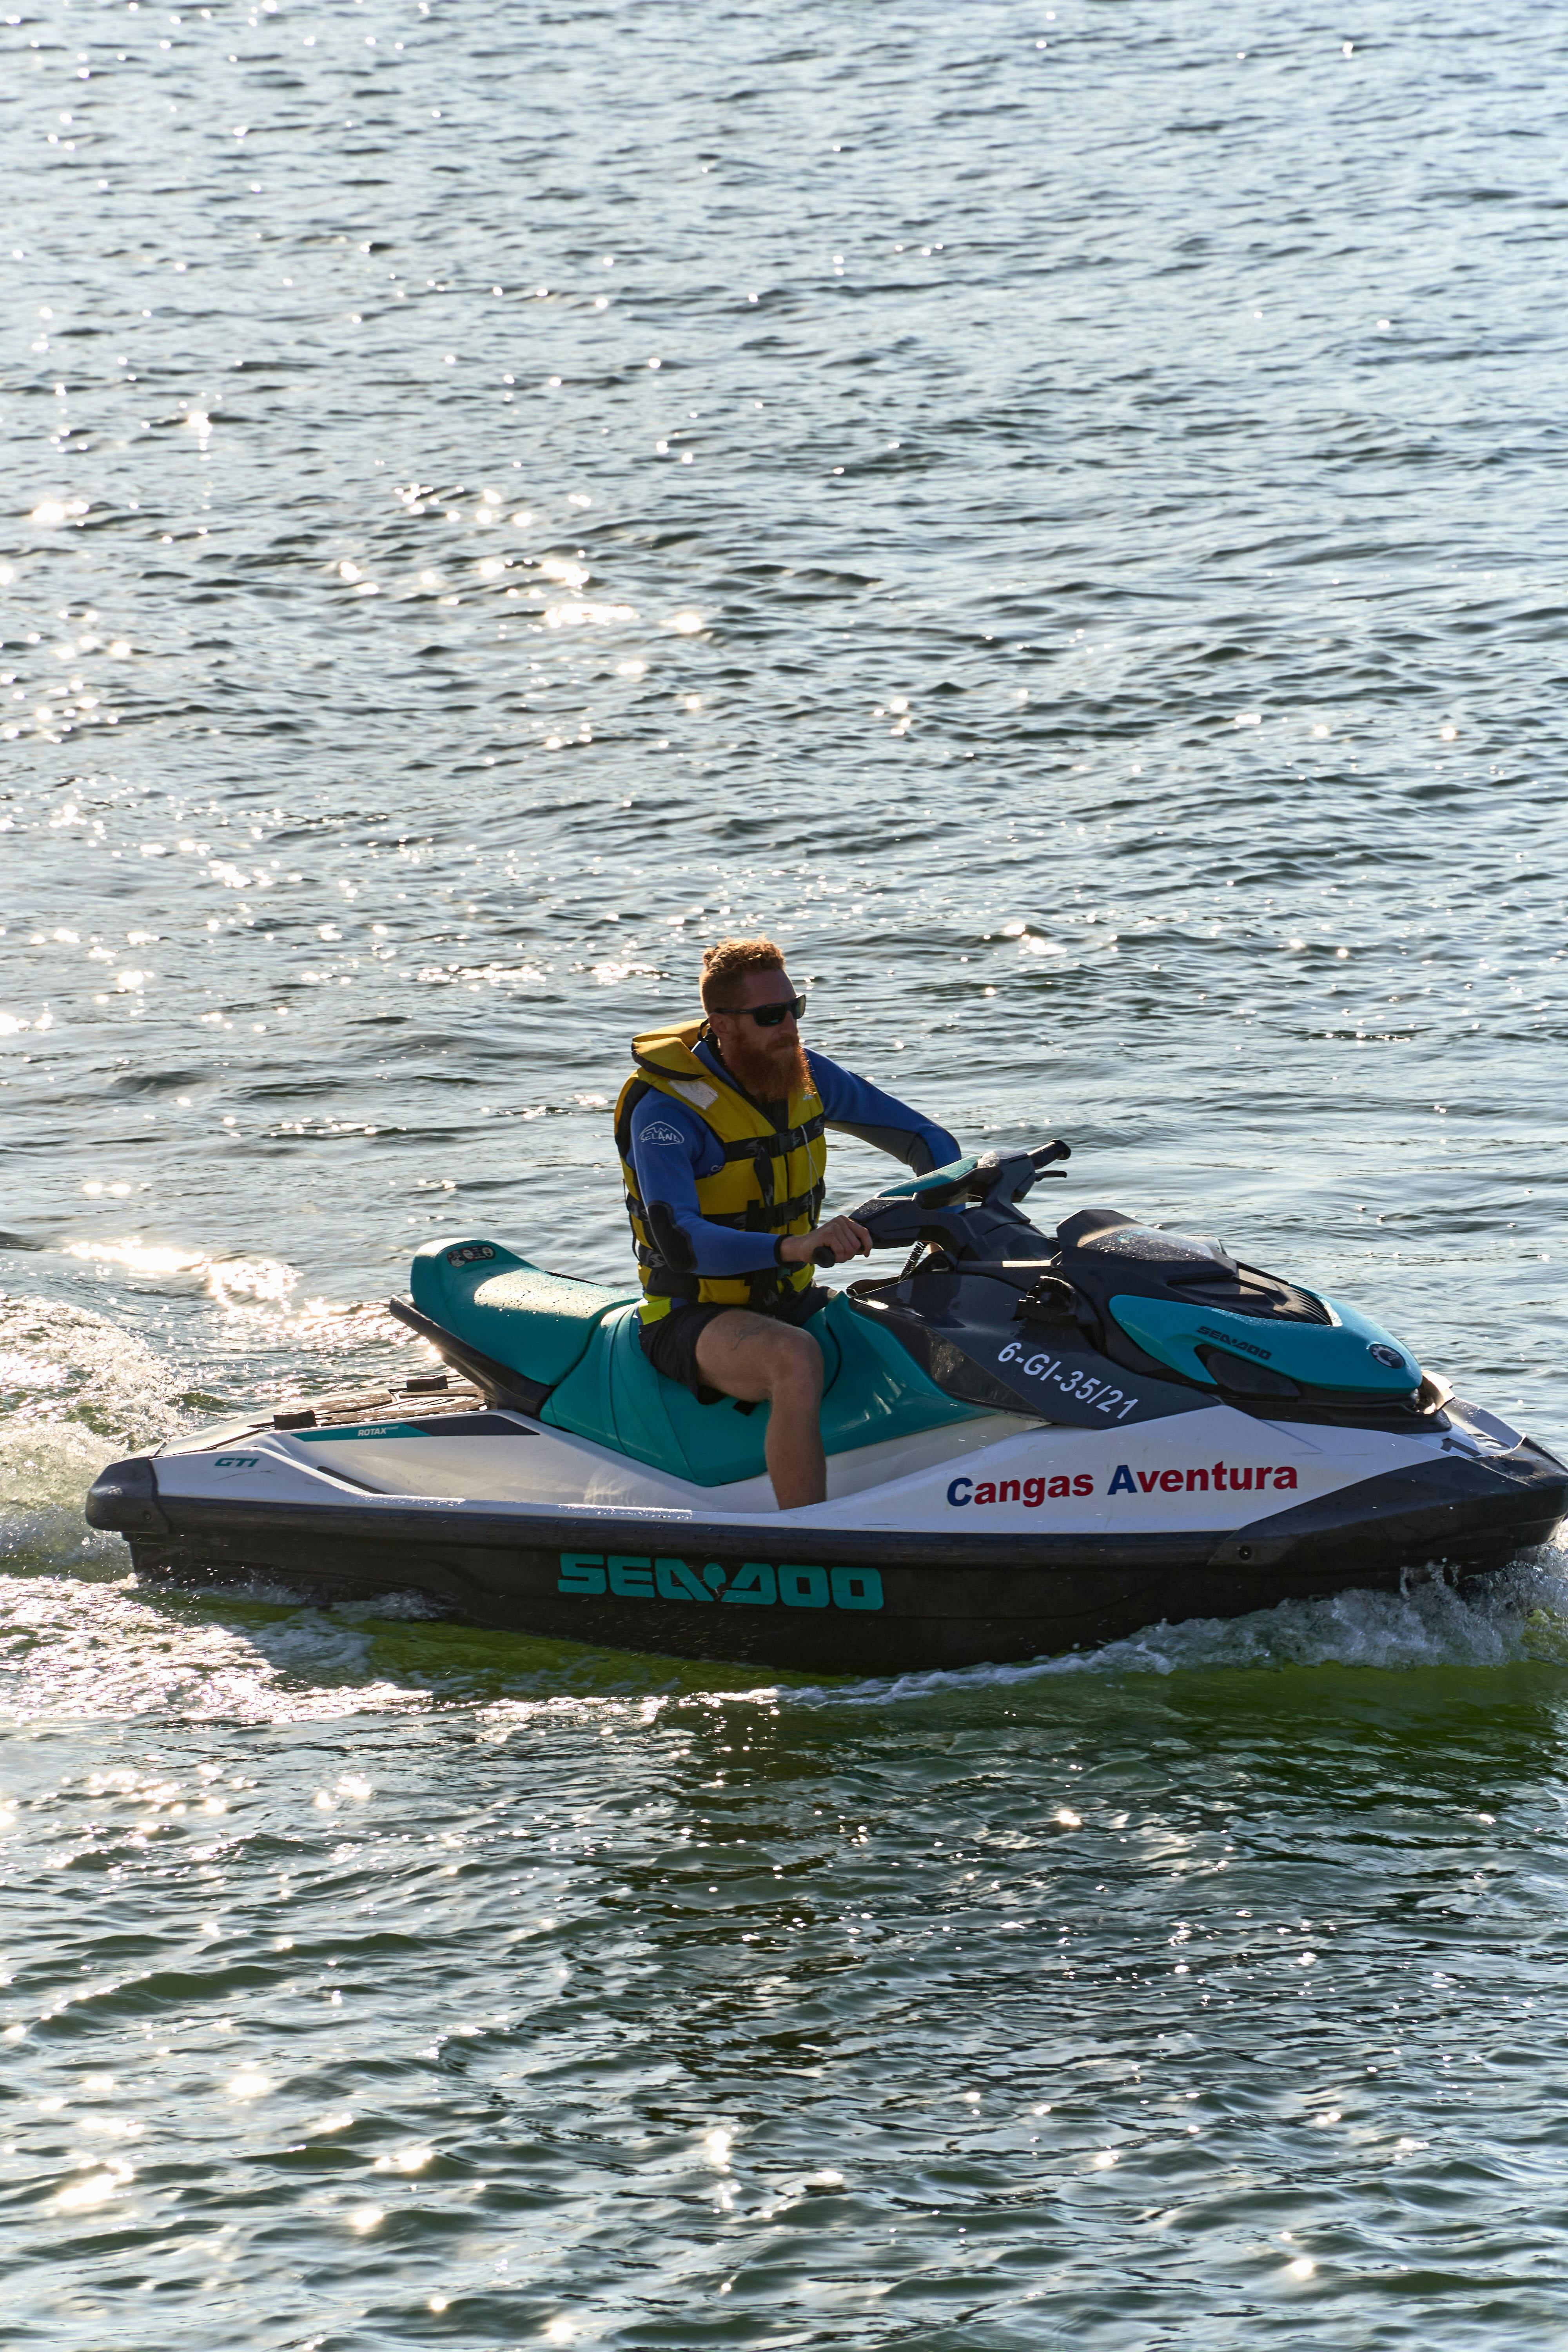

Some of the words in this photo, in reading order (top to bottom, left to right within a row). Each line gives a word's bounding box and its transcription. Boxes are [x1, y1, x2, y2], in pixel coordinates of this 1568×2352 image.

[641, 1131, 680, 1142] SELAND
[998, 1342, 1139, 1419] 6-GI-35/21
[357, 1428, 386, 1436] ROTAX
[214, 1458, 260, 1467] GTI
[947, 1472, 1094, 1508] Cangas
[1107, 1461, 1298, 1495] Aventura
